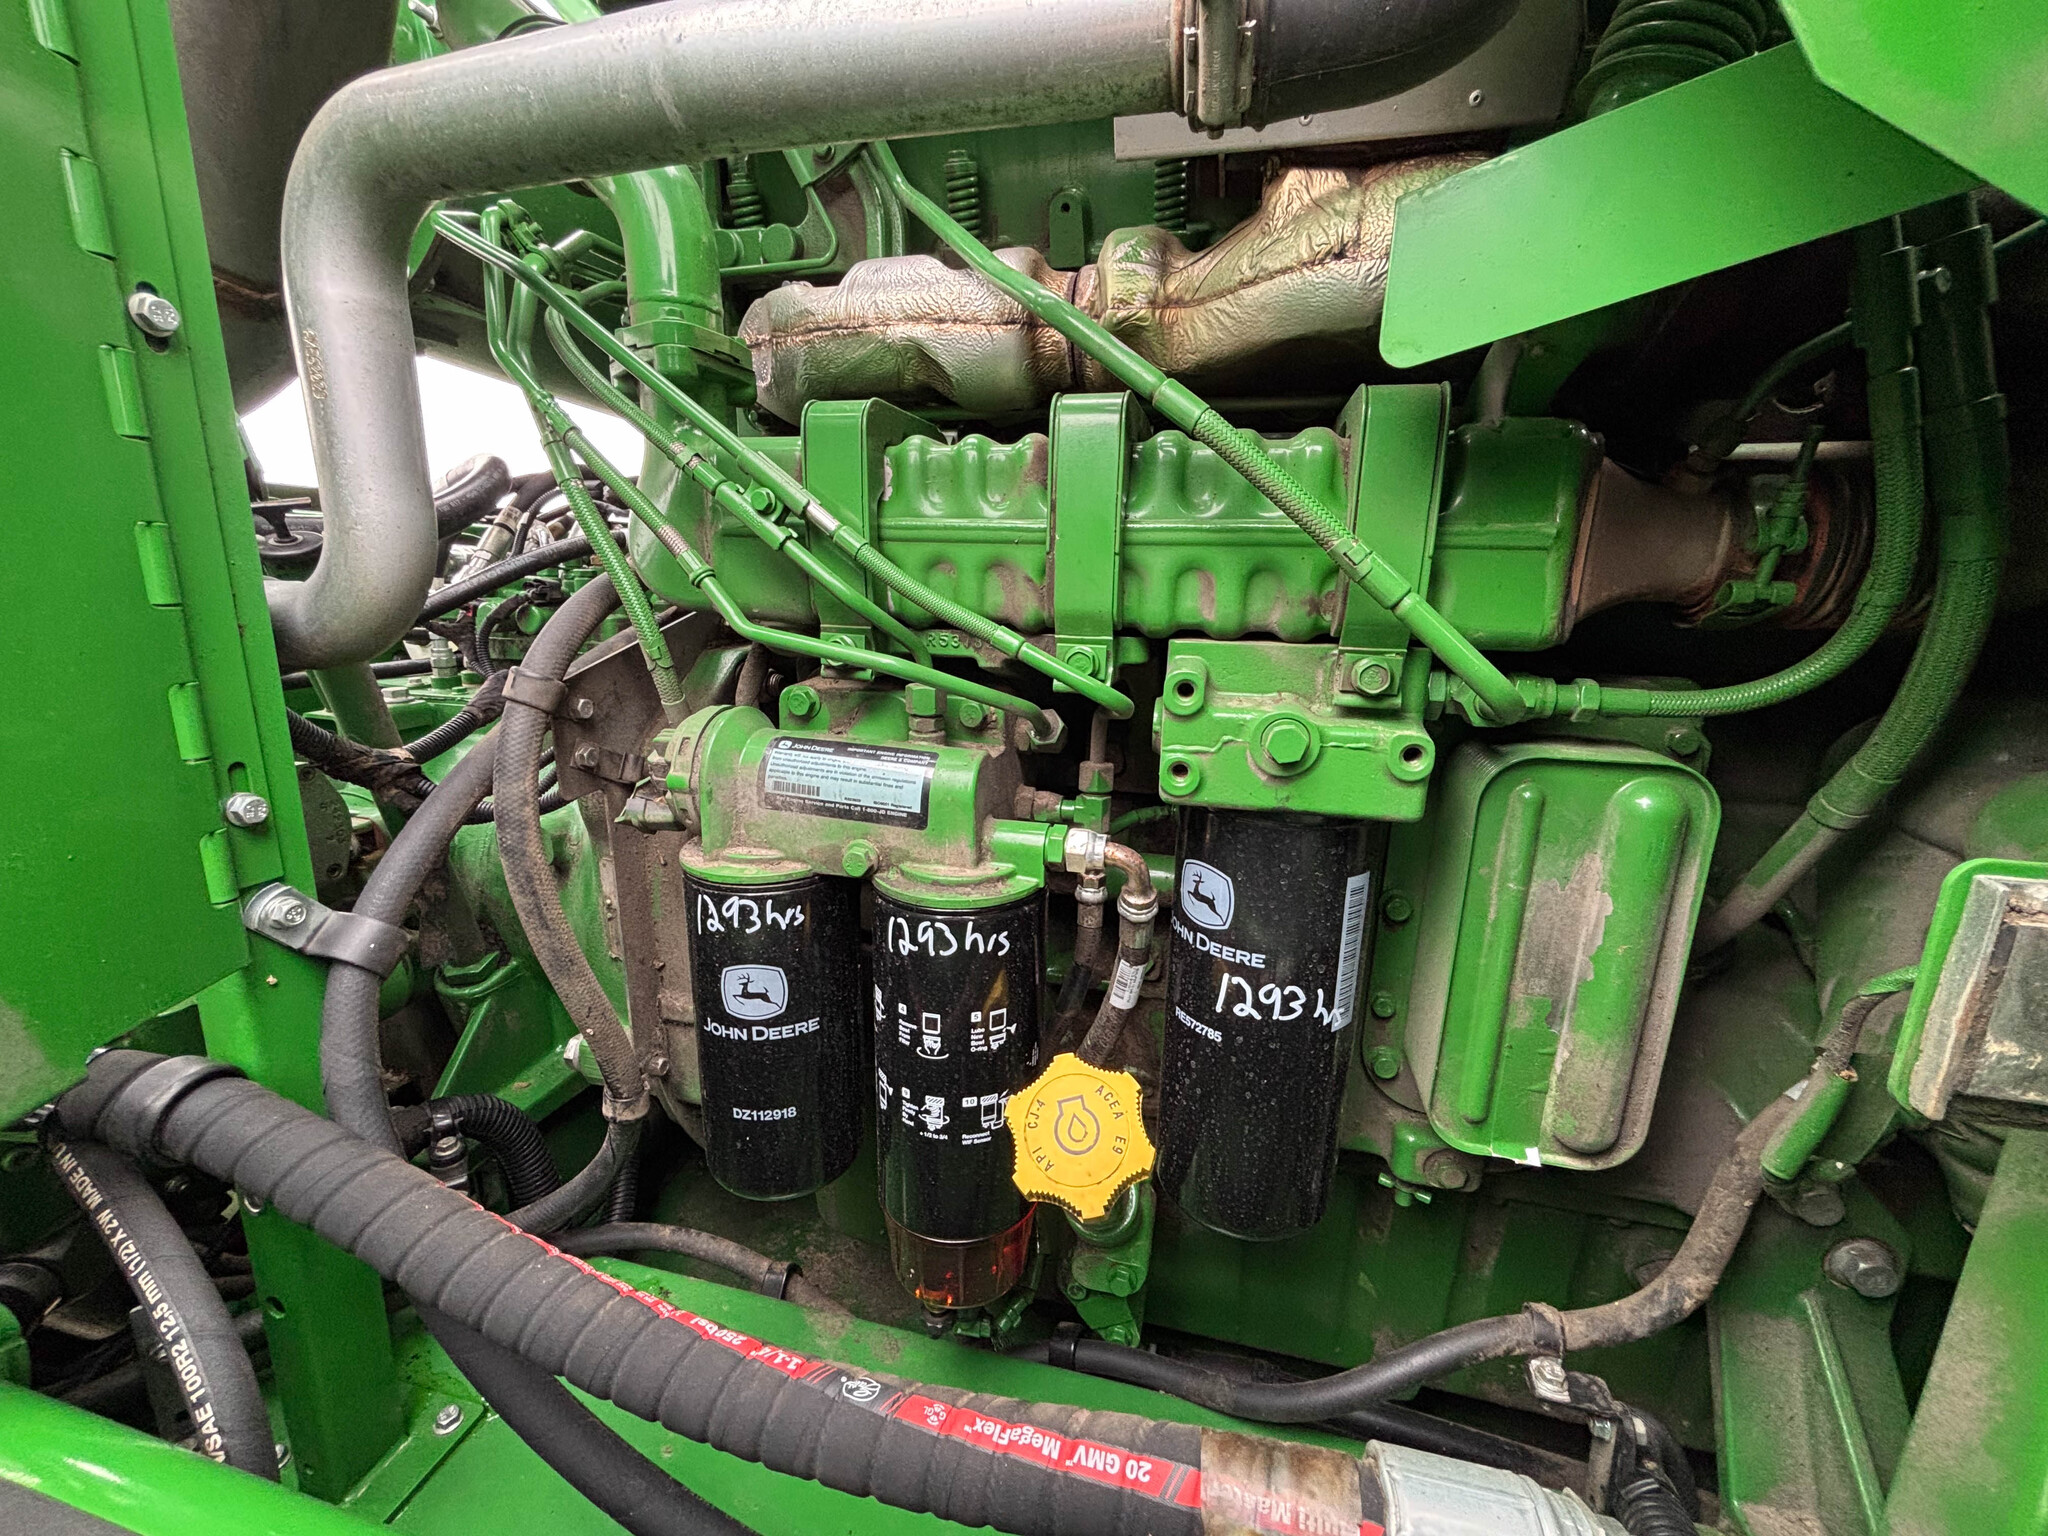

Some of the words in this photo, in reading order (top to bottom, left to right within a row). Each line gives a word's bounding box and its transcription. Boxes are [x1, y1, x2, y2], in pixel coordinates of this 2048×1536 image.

[697, 893, 762, 934] 1293
[766, 899, 805, 930] hrs
[888, 916, 958, 957] 1293
[965, 921, 1010, 956] hrs
[1196, 932, 1266, 969] DEERE
[1216, 973, 1307, 1021] 1293
[703, 1017, 748, 1041] JOHN
[751, 1017, 820, 1041] DEERE
[1175, 1005, 1223, 1042] RE572785
[732, 1106, 797, 1121] DZ112918
[1027, 1098, 1046, 1129] CJ-4
[1095, 1085, 1125, 1120] ACEA
[1112, 1135, 1127, 1155] E9
[59, 1152, 78, 1173] IN
[1032, 1146, 1055, 1172] API
[69, 1166, 103, 1211] MADE
[96, 1208, 119, 1235] 2W
[110, 1228, 128, 1248] X
[118, 1240, 146, 1277] (1/2)
[137, 1270, 162, 1305] mm
[152, 1302, 181, 1342] 12,5
[171, 1338, 206, 1403] 100R2
[1125, 1459, 1153, 1483] 20
